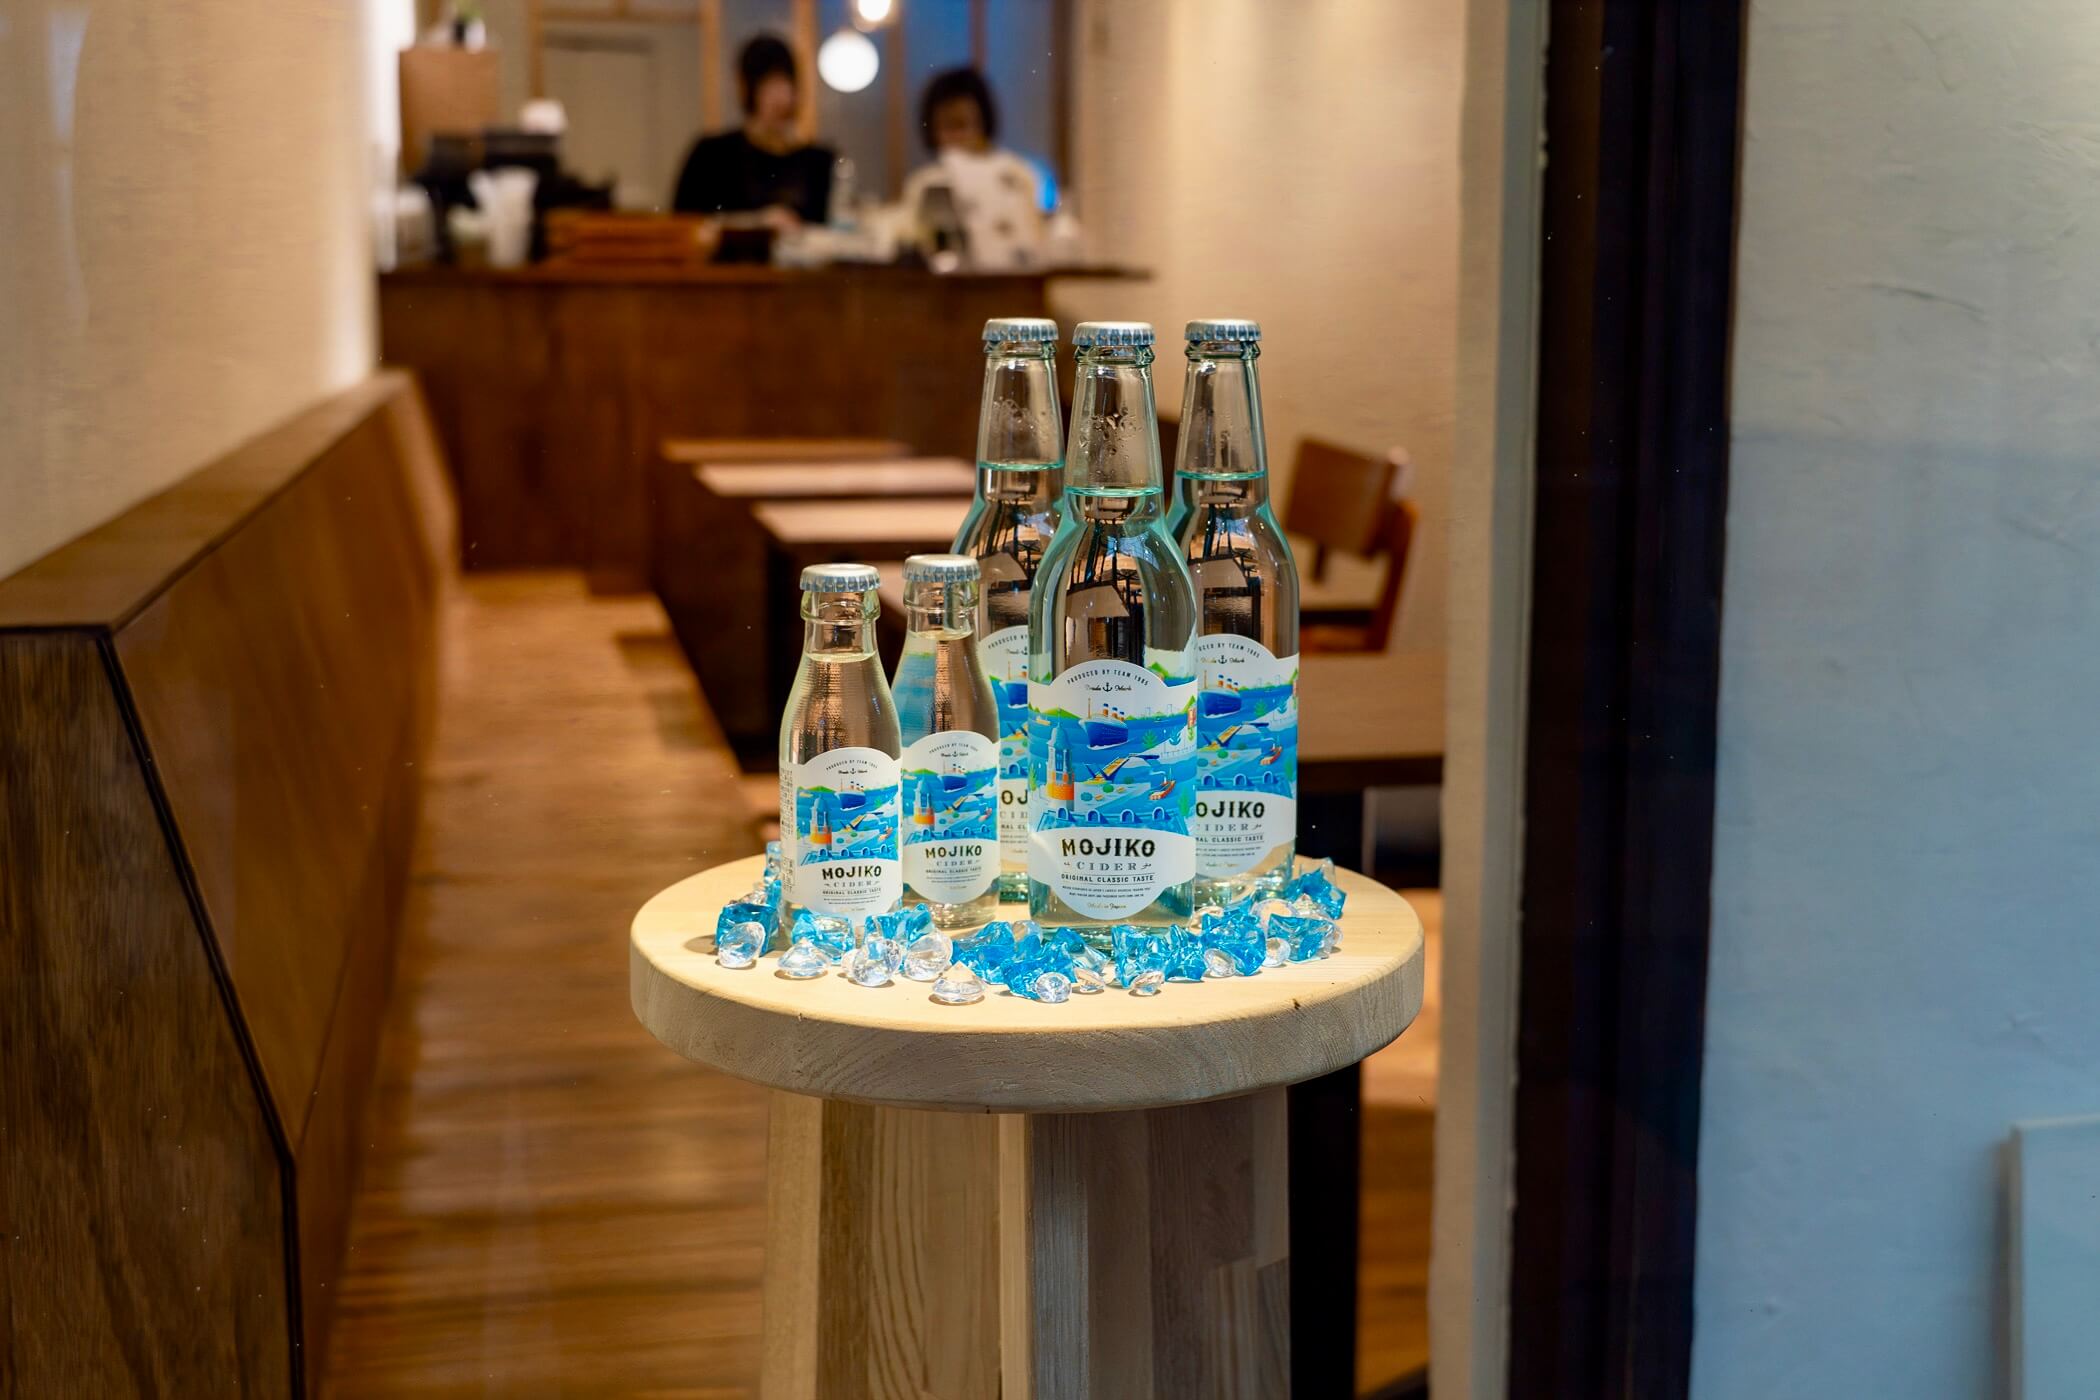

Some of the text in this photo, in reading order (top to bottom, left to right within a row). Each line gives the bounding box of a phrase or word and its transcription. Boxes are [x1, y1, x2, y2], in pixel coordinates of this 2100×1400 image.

[1067, 669, 1098, 685] PRODUCED
[1114, 669, 1132, 678] TEAM
[1195, 801, 1265, 818] OJIKO
[925, 845, 982, 859] MOJIKO
[1061, 838, 1156, 858] MOJIKO
[936, 859, 973, 867] CIDER
[1076, 861, 1137, 871] CIDER
[822, 865, 882, 880] MOJIKO
[1061, 873, 1093, 882] ORIGINAL
[833, 880, 872, 888] CIDER
